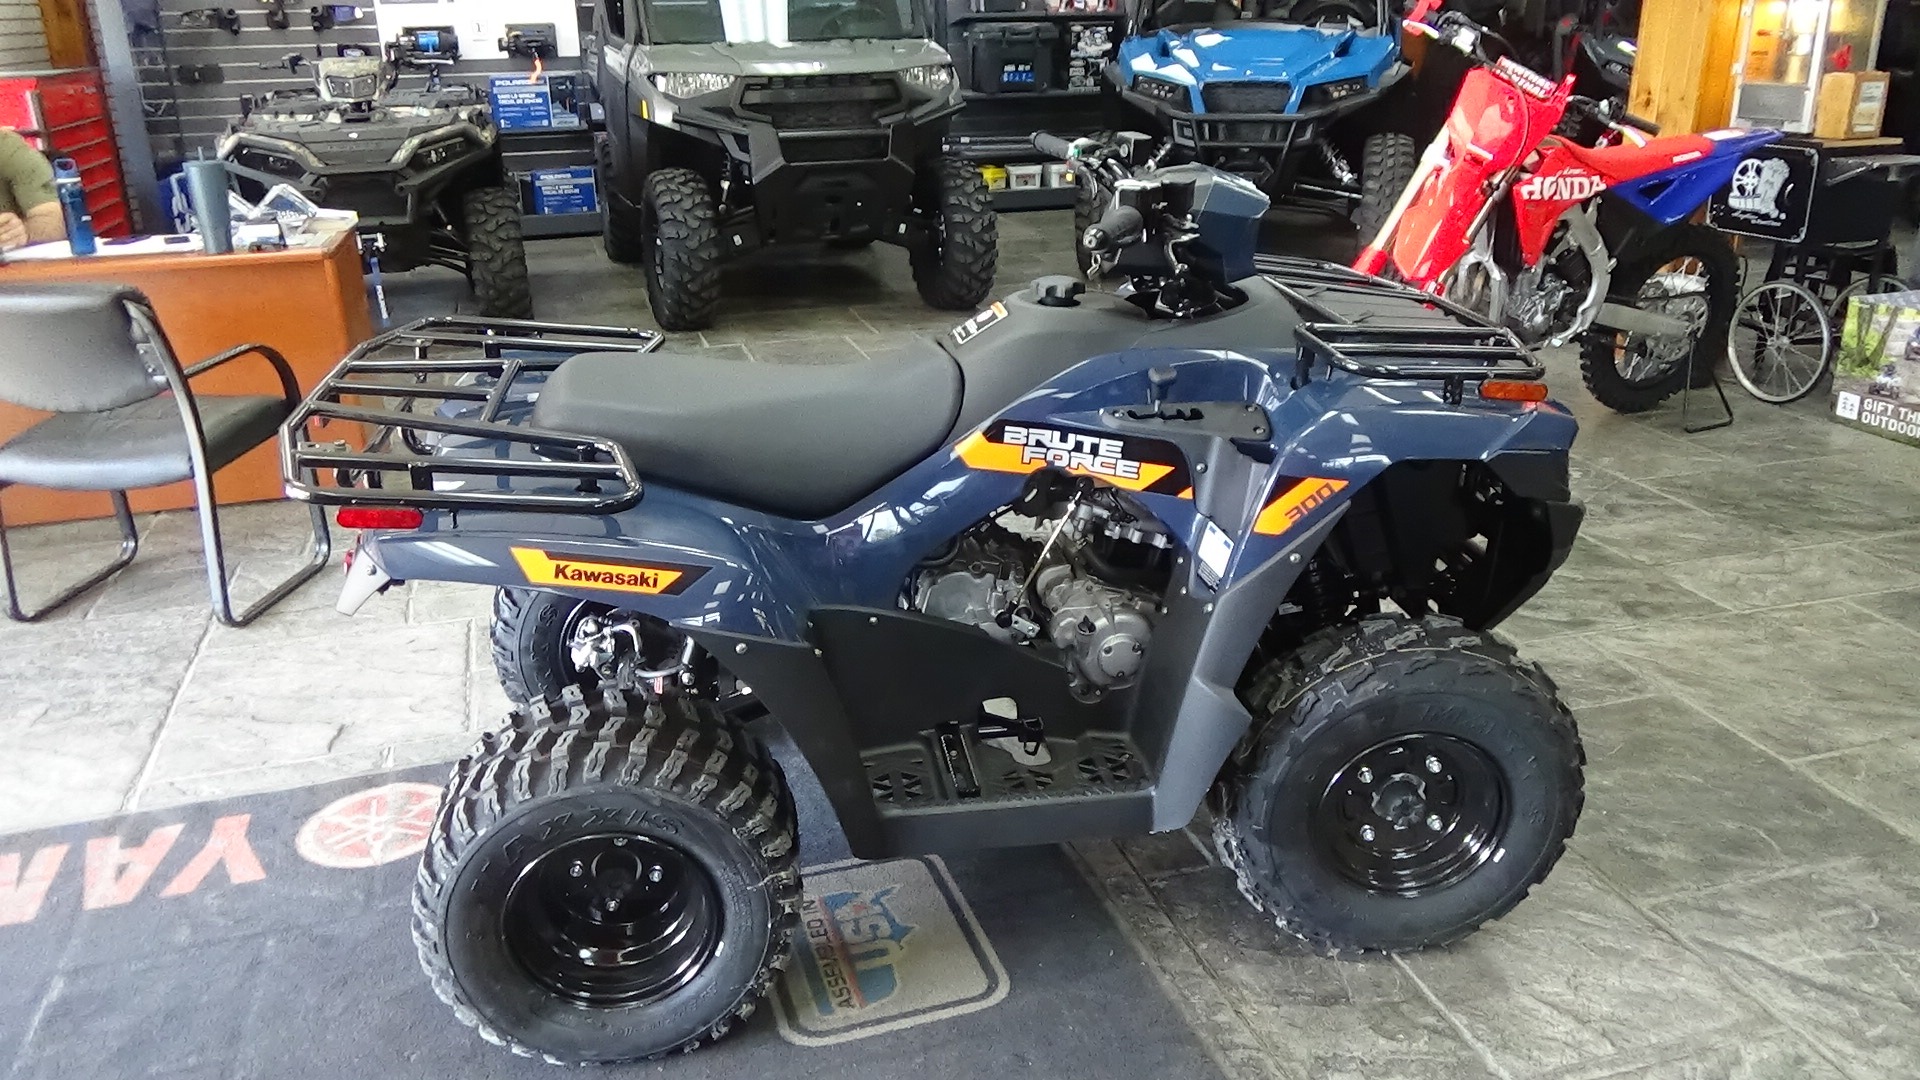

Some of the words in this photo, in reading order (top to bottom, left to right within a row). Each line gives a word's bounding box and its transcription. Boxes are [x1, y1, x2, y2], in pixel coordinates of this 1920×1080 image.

[1521, 174, 1608, 201] HONDA
[1863, 398, 1894, 416] GIFT
[1003, 425, 1124, 459] BRUTE
[1021, 445, 1140, 480] FORCE
[1284, 482, 1335, 521] 300
[554, 563, 659, 588] Kawasaki
